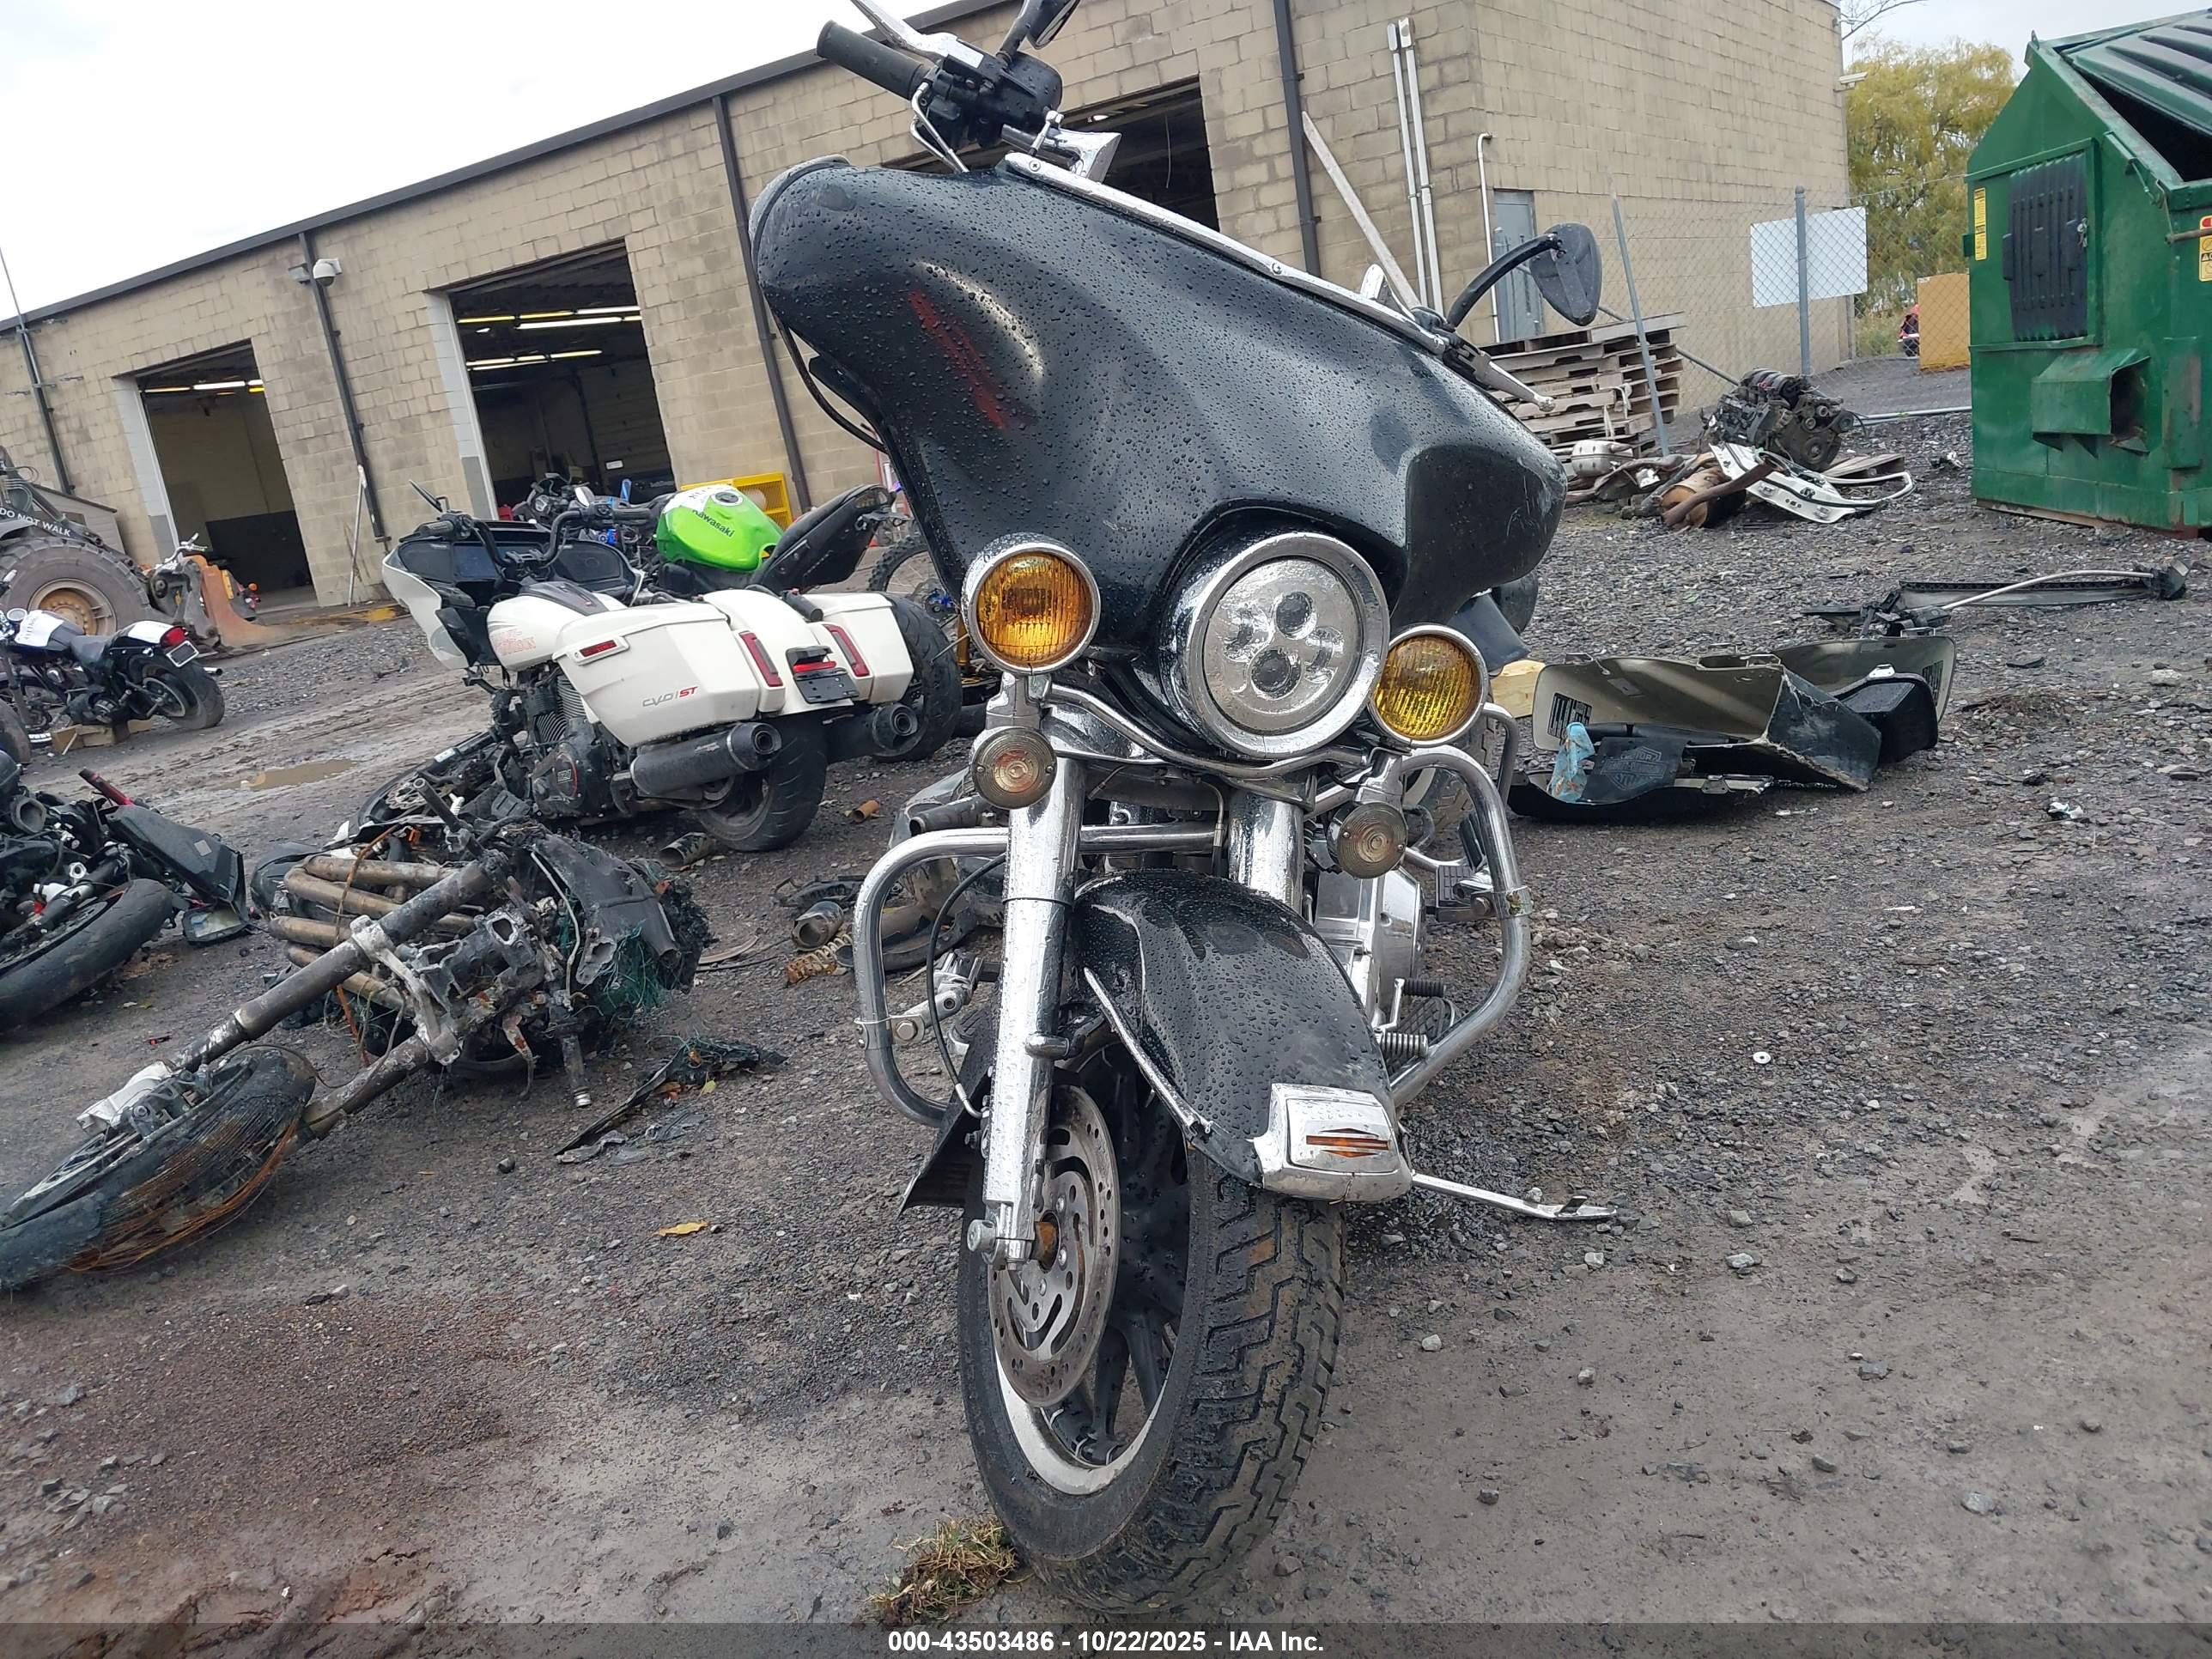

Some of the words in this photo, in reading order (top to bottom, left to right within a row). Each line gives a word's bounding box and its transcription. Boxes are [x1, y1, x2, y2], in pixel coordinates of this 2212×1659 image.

[0, 507, 15, 519] DO
[17, 513, 40, 526] NOT
[42, 521, 71, 537] WALK
